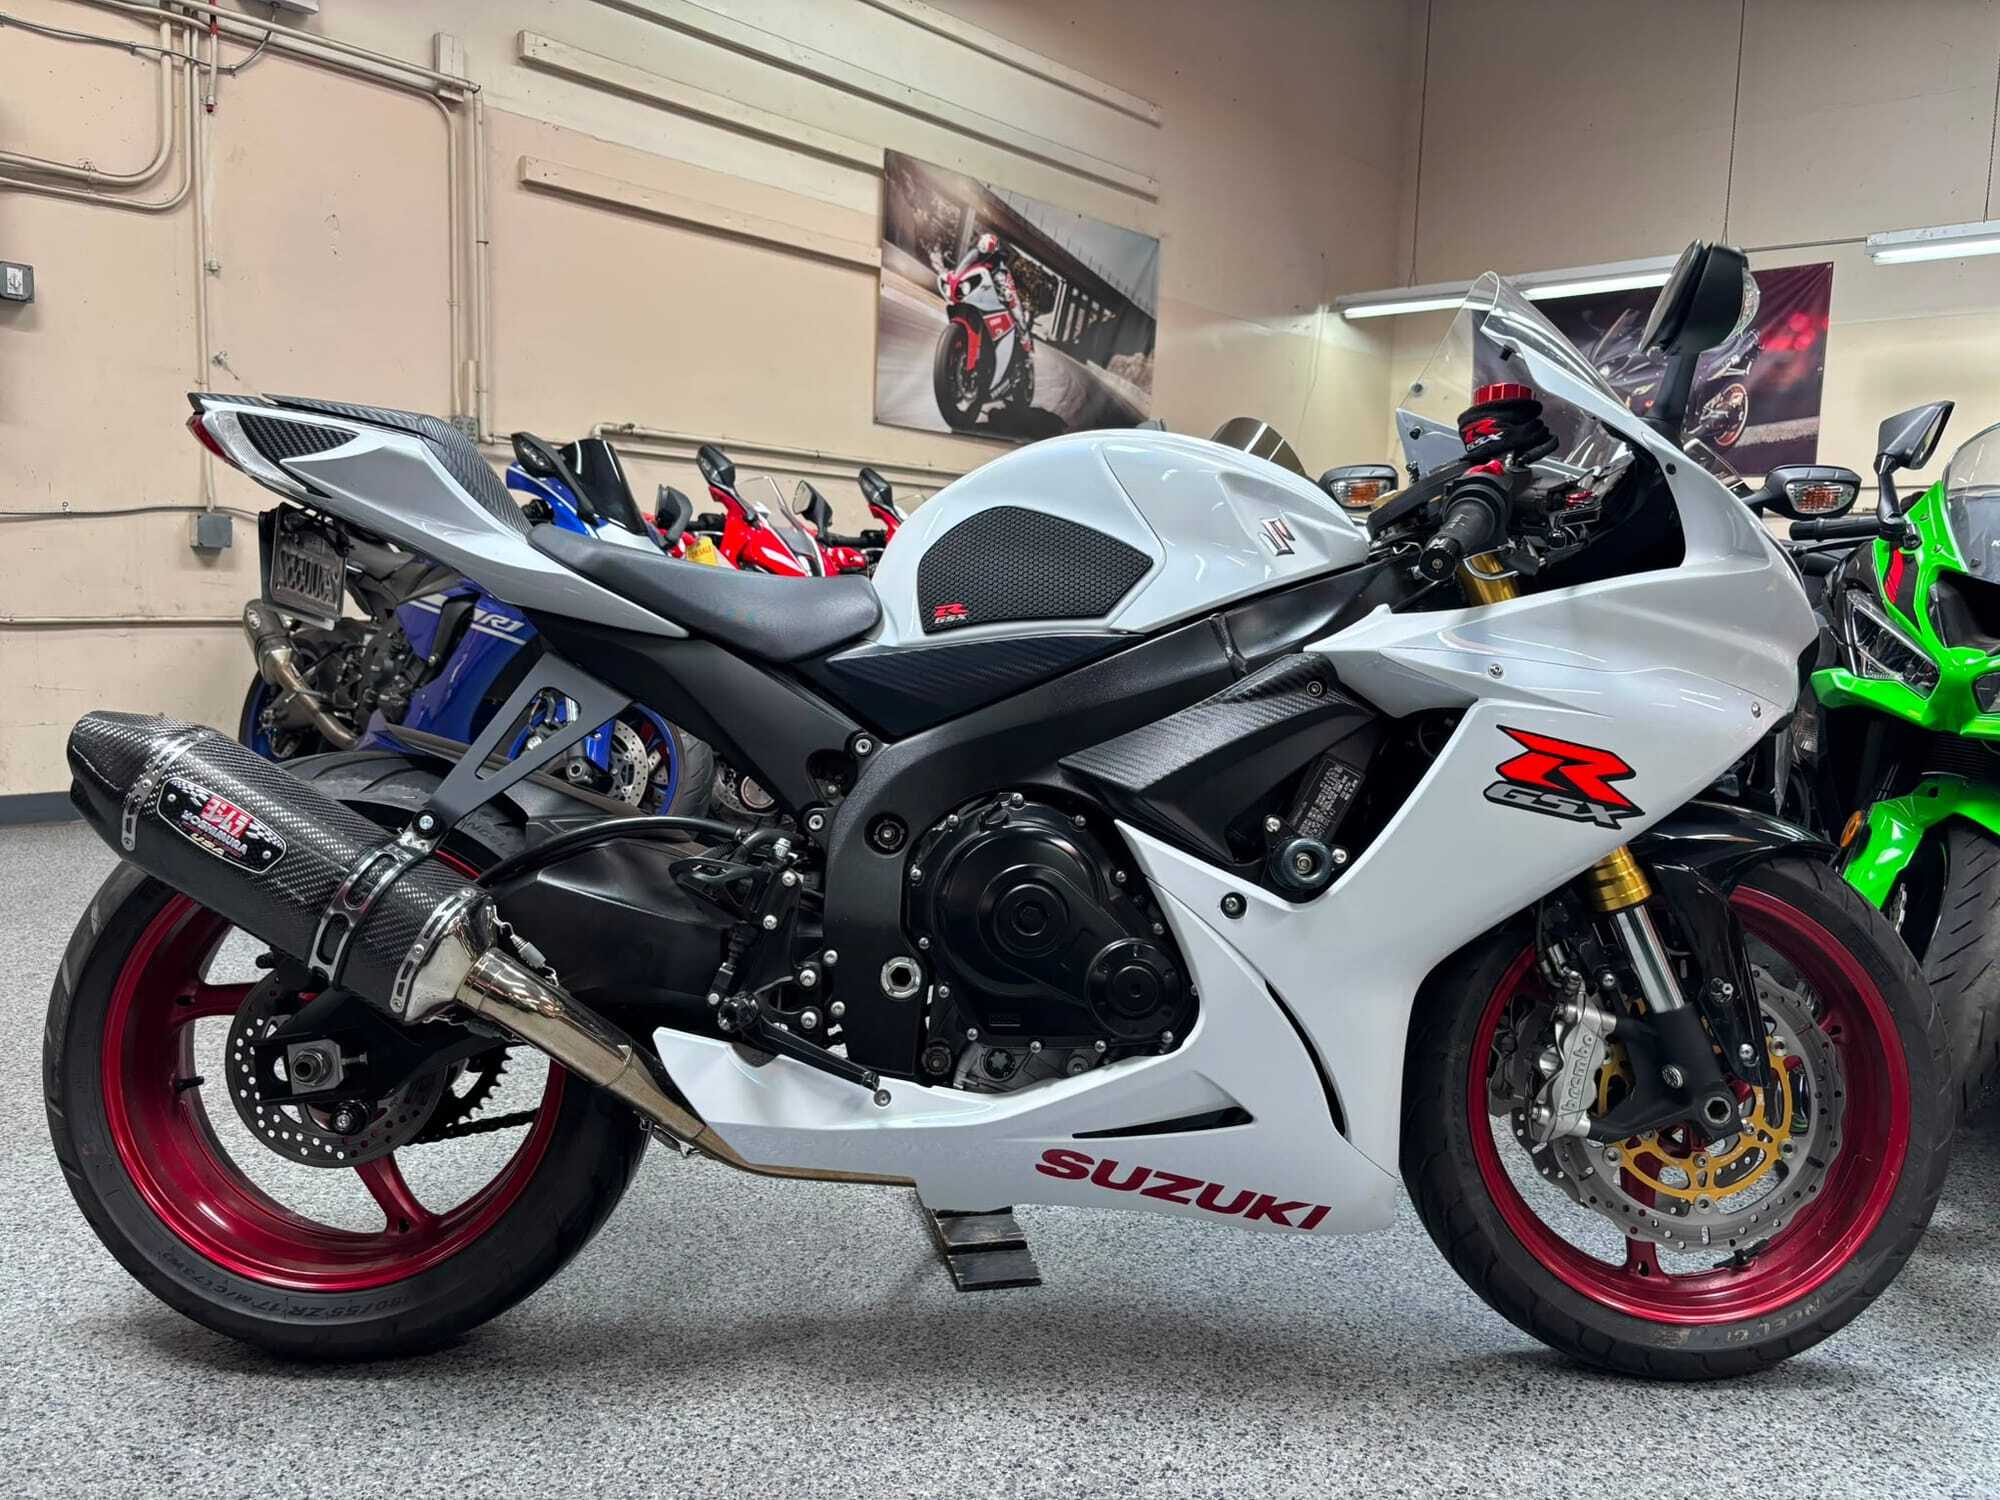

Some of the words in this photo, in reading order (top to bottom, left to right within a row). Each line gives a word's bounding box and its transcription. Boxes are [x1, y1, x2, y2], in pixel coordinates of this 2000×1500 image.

[481, 614, 525, 633] R1
[1483, 780, 1637, 830] GSX
[181, 809, 249, 856] YOSHIMURA
[191, 833, 226, 857] USA
[1560, 1033, 1594, 1112] brembo
[1034, 1148, 1332, 1230] SUZUKI
